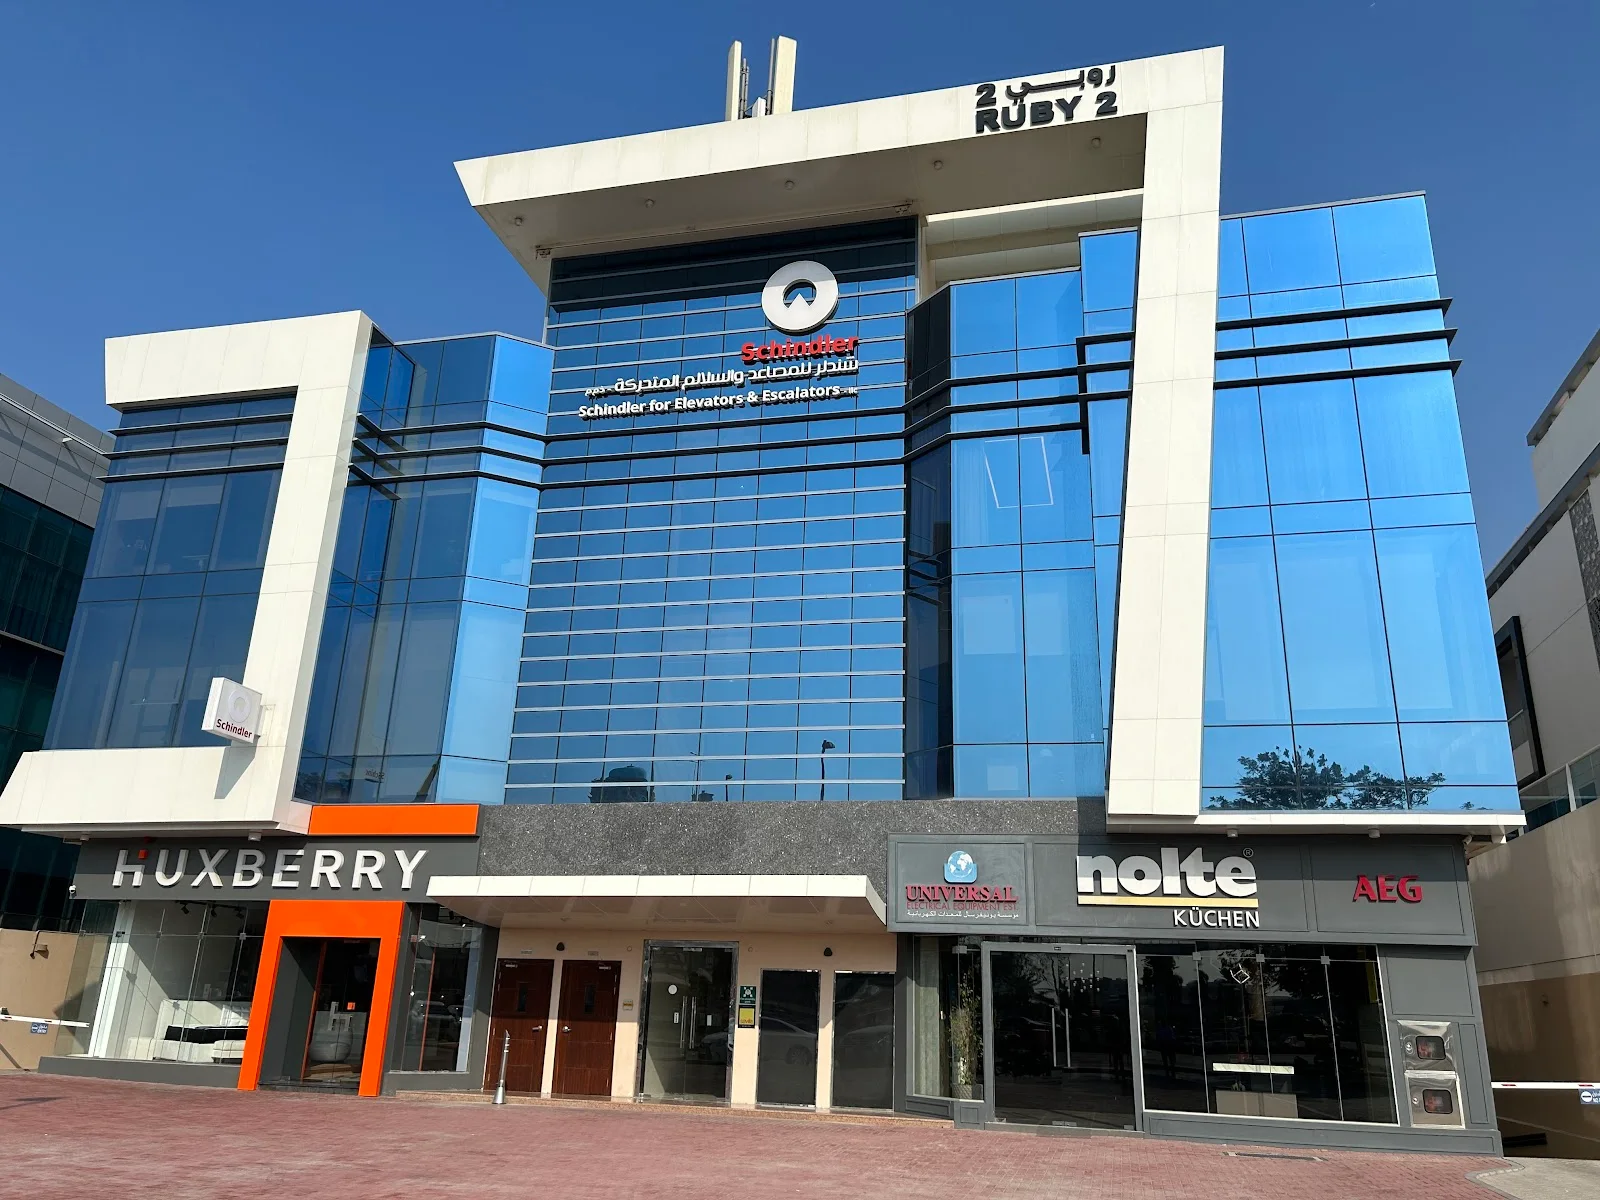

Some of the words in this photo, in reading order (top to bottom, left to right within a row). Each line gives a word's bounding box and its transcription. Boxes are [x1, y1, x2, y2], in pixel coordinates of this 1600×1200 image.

[976, 83, 996, 108] 2
[1006, 64, 1116, 106] روبي
[976, 95, 1083, 134] RUBY
[1095, 91, 1118, 117] 2
[741, 334, 858, 361] Schindler
[748, 361, 812, 380] للمصاعد
[814, 356, 859, 377] شندلر
[614, 374, 680, 394] المتحركة
[681, 369, 744, 391] والسلالم
[579, 401, 646, 417] Schindler
[649, 398, 672, 413] for
[674, 393, 744, 410] Elevators
[747, 390, 759, 403] &
[763, 385, 840, 402] Escalators
[216, 718, 253, 739] Schindler
[112, 849, 427, 889] HUXBERRY
[1076, 847, 1258, 897] nolte
[905, 885, 1019, 902] UNIVERSAL
[1353, 874, 1423, 903] AEG
[906, 901, 951, 910] ELECTRICAL
[953, 901, 1001, 911] EQUIPMENT
[1173, 906, 1260, 928] KÜCHEN
